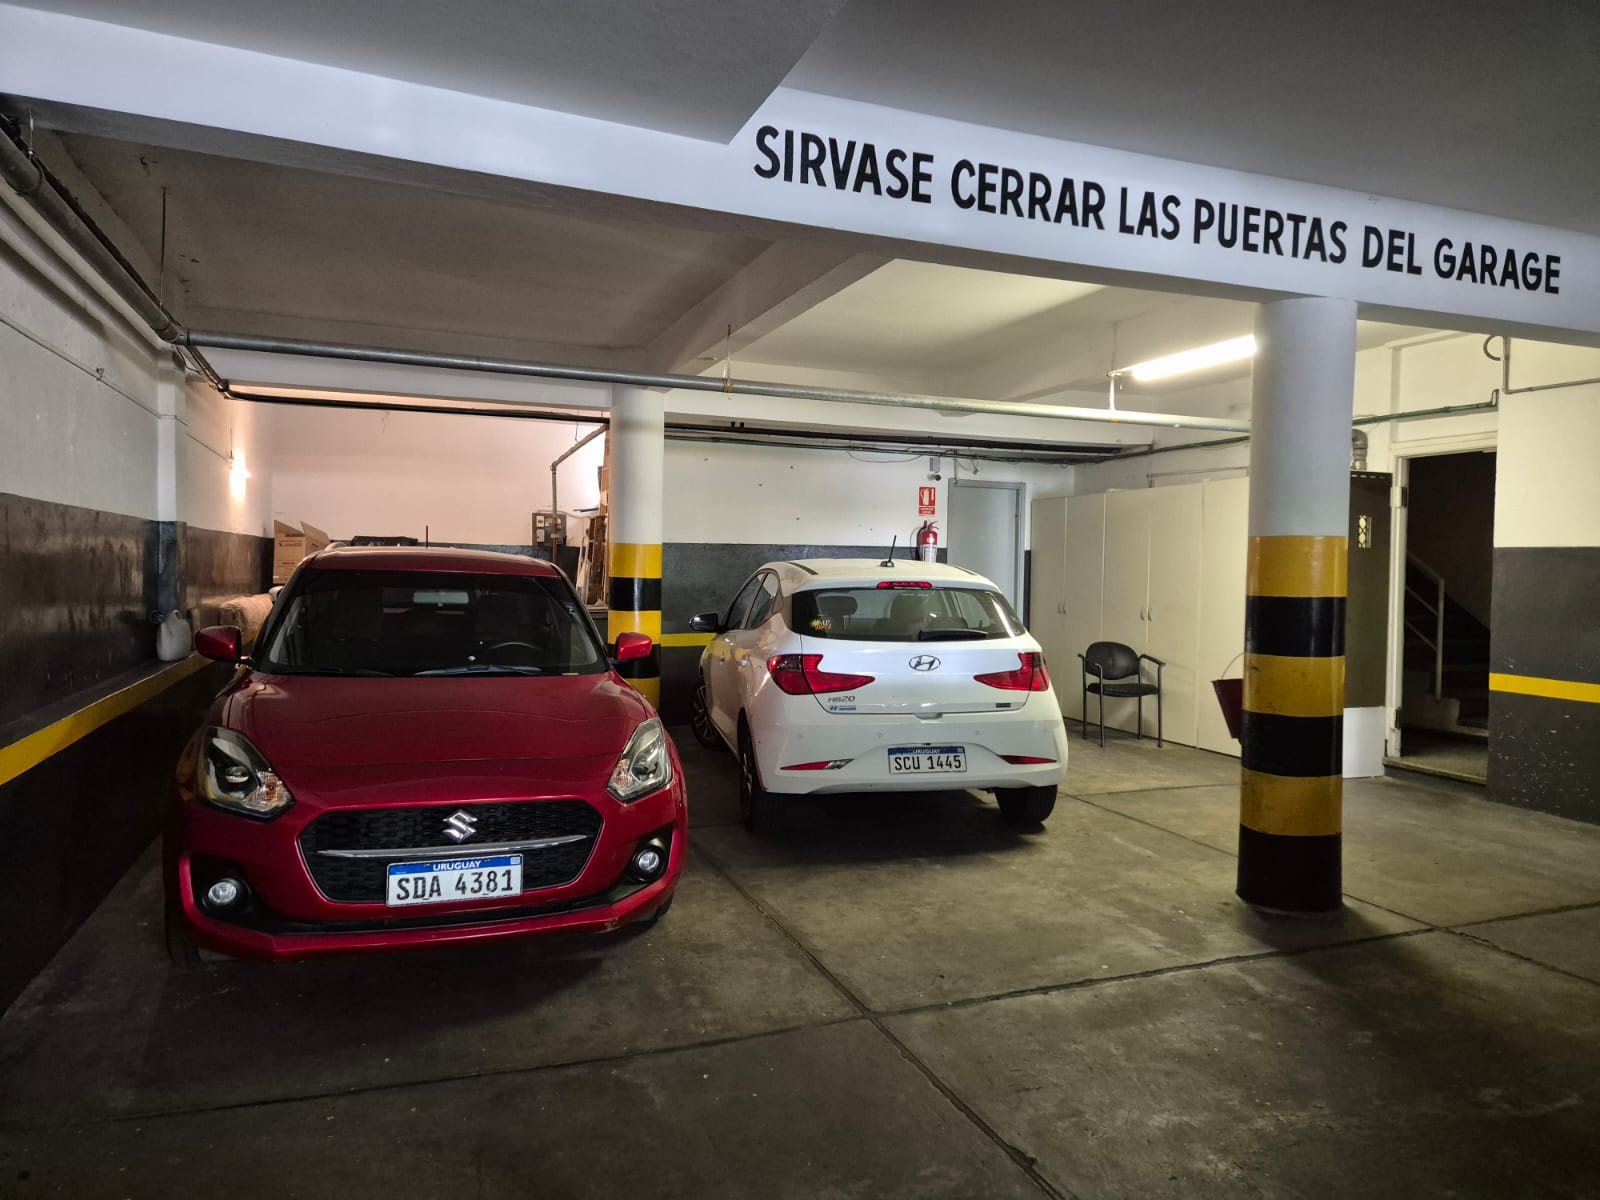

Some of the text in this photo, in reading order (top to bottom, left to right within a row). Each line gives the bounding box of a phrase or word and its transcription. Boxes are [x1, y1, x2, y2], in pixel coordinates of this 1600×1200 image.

[754, 125, 1561, 294] SIRVASE CERRAR LAS PUERTAS DEL GARAGE
[894, 755, 962, 771] SCU 1445
[432, 860, 482, 871] URUGUAY
[396, 869, 513, 901] SDA 4381
